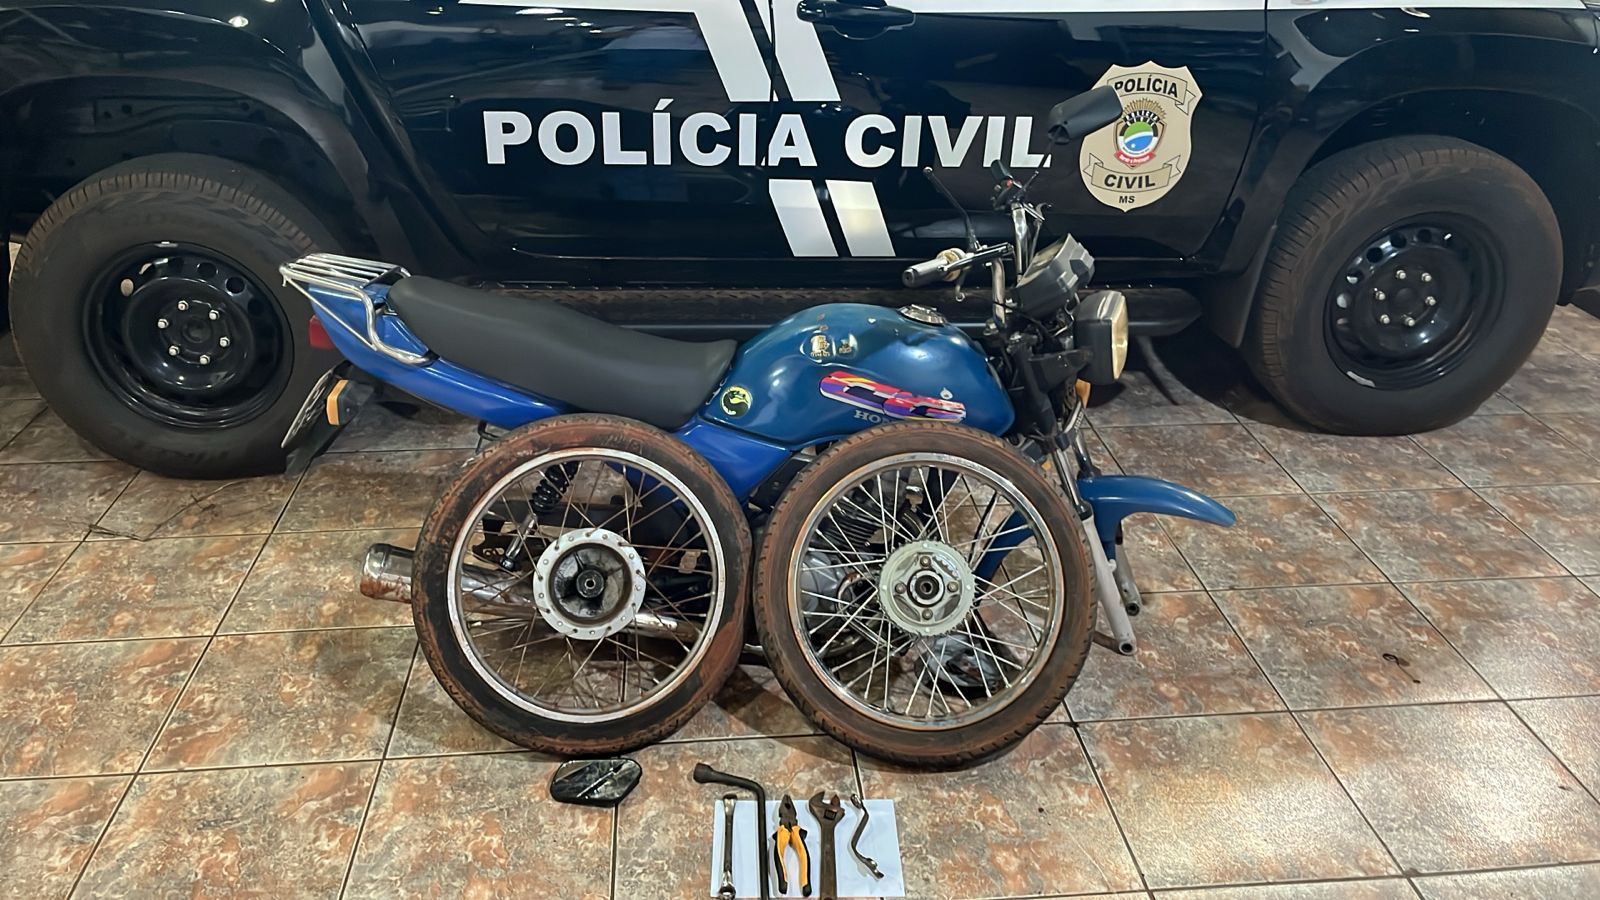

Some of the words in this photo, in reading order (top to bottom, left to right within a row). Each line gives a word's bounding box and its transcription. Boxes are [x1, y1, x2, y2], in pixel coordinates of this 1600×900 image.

[1114, 74, 1178, 98] POLÍCIA
[483, 98, 818, 168] POLÍCIA
[844, 114, 1051, 169] CIVIL
[1104, 174, 1156, 189] CIVIL
[1118, 195, 1136, 204] MS
